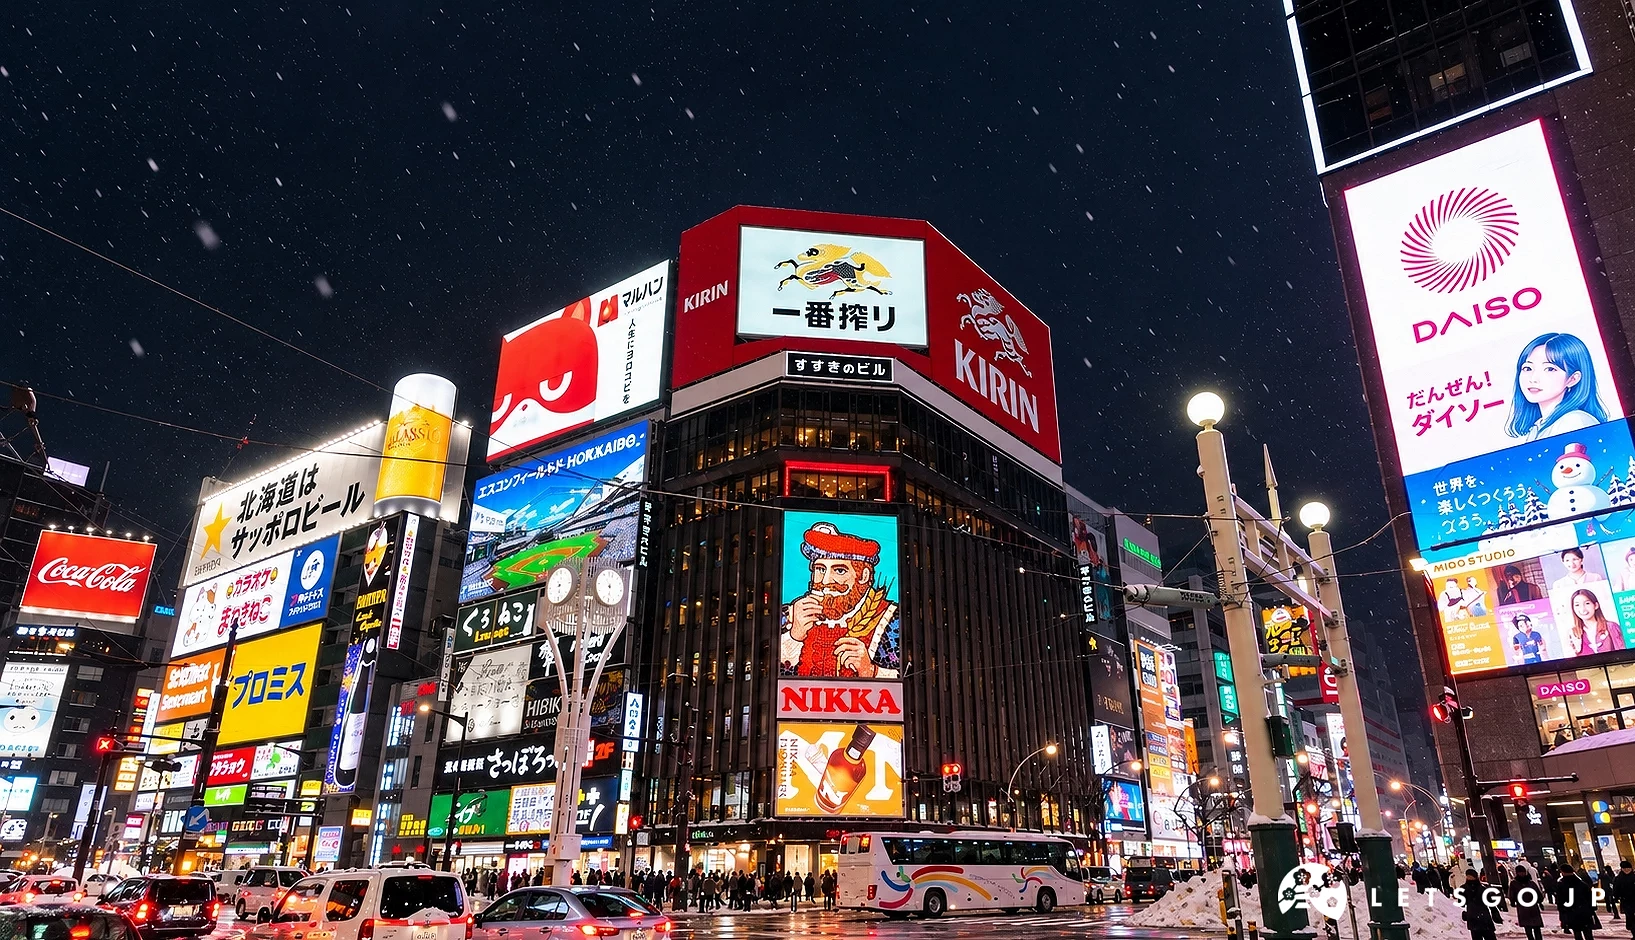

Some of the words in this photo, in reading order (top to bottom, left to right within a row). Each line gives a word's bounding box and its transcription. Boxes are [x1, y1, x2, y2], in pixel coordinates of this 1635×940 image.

[622, 276, 664, 307] マルハン
[683, 280, 729, 313] KIRIN
[772, 301, 896, 331] 一番搾り
[1412, 287, 1543, 343] DAISO
[953, 338, 1040, 434] KIRIN
[1411, 399, 1505, 437] ダイソー
[236, 462, 320, 524] 北海道は
[231, 482, 366, 559] サッポロビール
[37, 557, 147, 592] Coca-Cola
[233, 569, 271, 597] カラオケ
[231, 663, 307, 709] プロミス
[780, 687, 902, 714] NIKKA
[1540, 681, 1587, 696] DAISO
